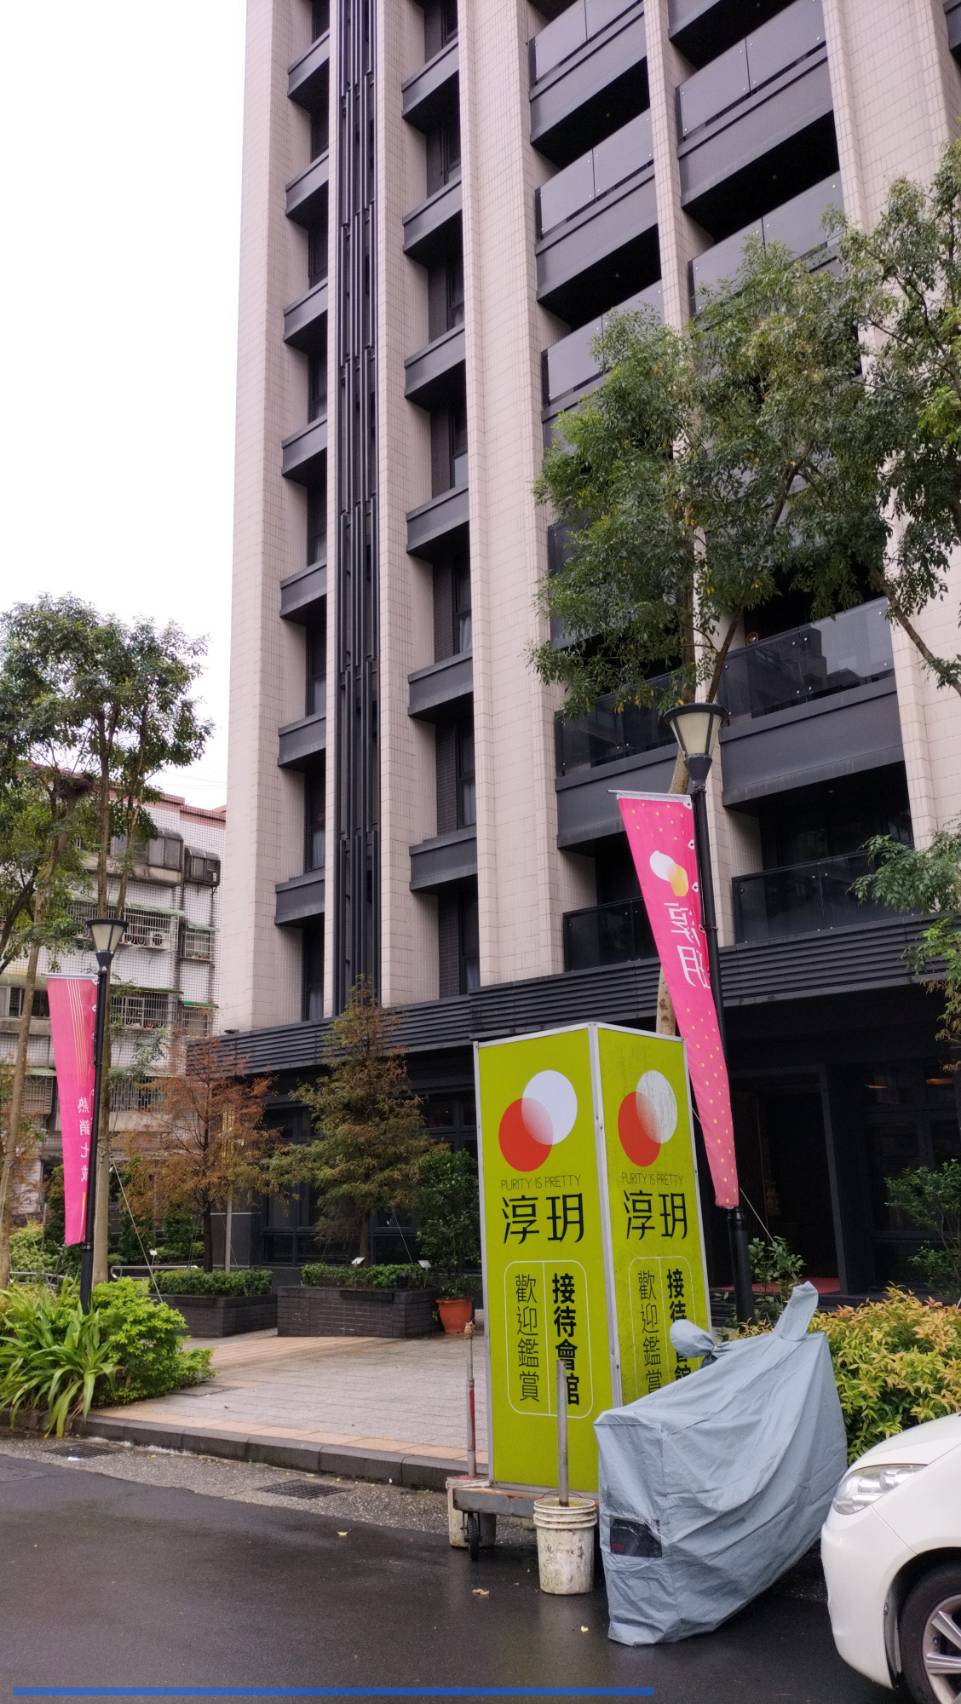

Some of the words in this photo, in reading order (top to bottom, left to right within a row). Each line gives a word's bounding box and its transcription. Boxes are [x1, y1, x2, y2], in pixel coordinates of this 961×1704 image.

[501, 1177, 532, 1191] PURITY
[534, 1177, 542, 1190] IS
[545, 1174, 581, 1188] PRETTY
[622, 1172, 647, 1185] PURITY
[649, 1173, 655, 1185] IS
[656, 1174, 683, 1186] PRETTY
[501, 1192, 584, 1244] 淳玥
[623, 1190, 688, 1240] 淳玥
[515, 1274, 540, 1402] 歡迎鑑賞
